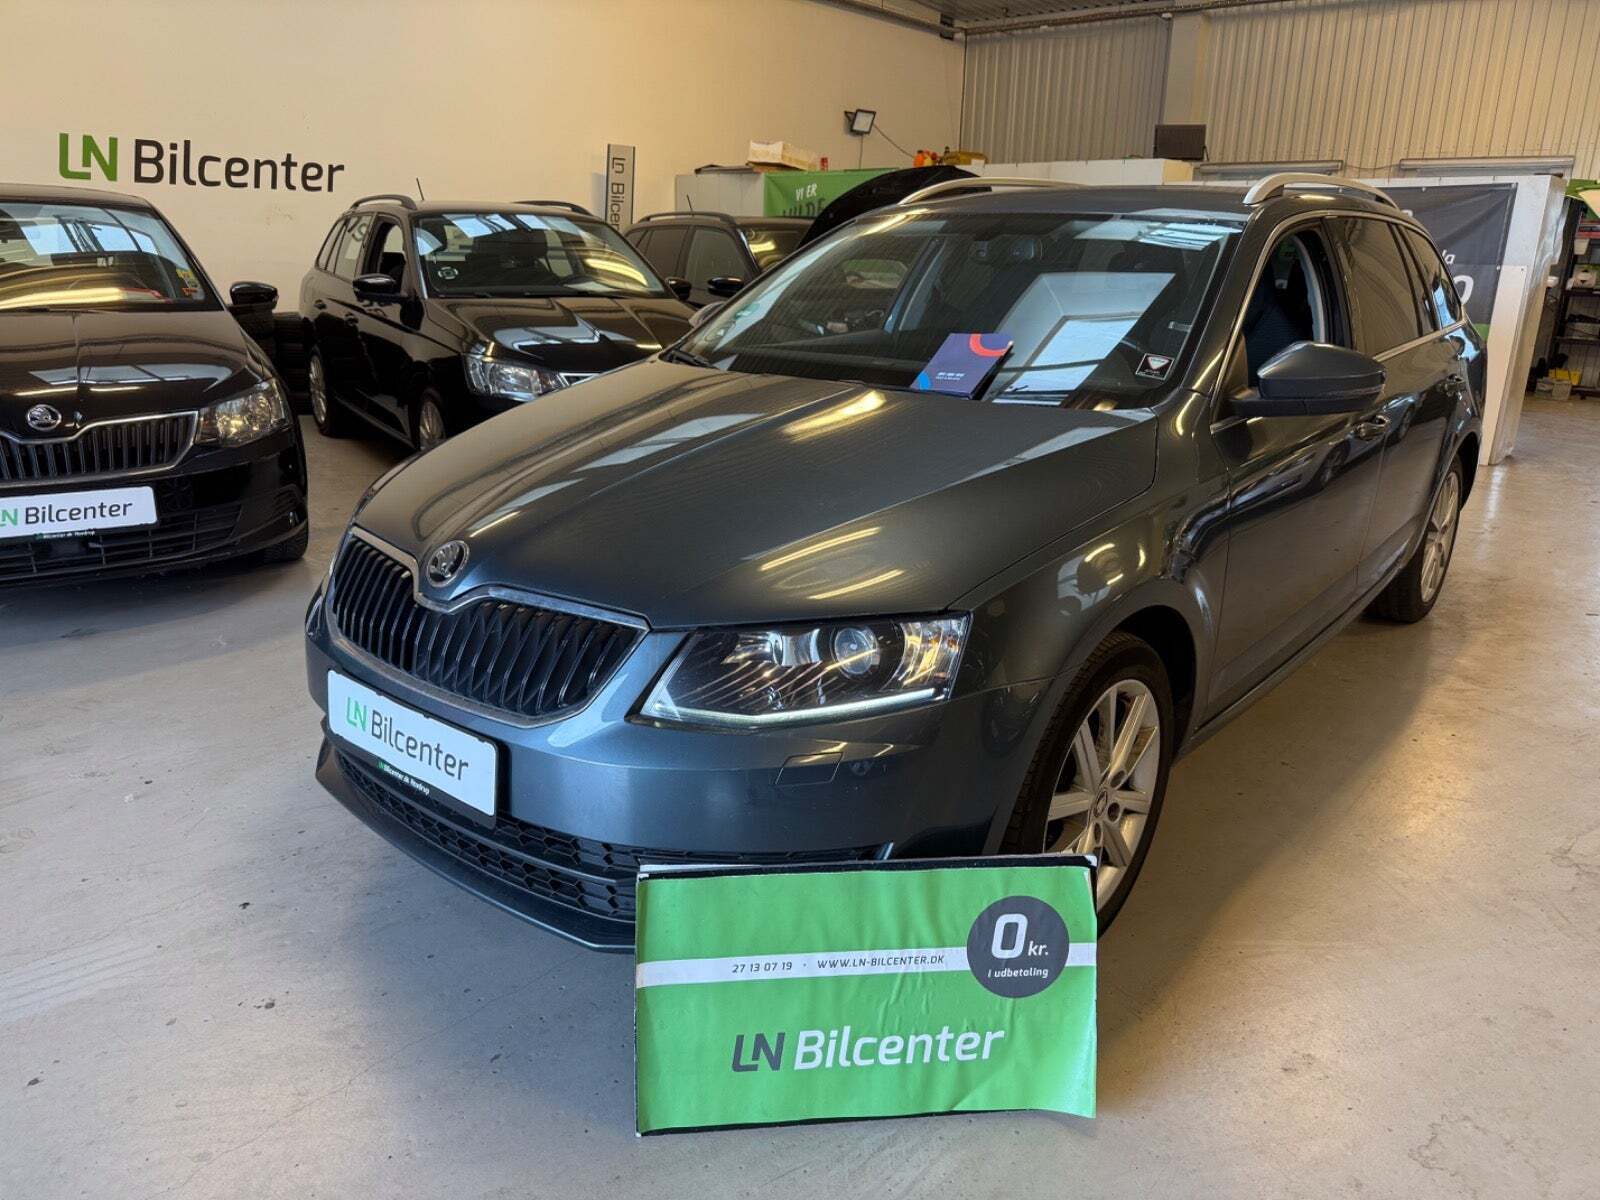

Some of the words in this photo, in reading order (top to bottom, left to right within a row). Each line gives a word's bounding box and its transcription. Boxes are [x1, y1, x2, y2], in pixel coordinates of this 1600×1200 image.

[59, 133, 118, 182] LN
[134, 139, 345, 192] Bilcenter
[612, 157, 626, 174] Ln
[806, 183, 817, 198] ER
[0, 508, 18, 527] N
[25, 501, 133, 525] Bilcenter
[346, 697, 367, 732] LN
[371, 709, 469, 780] Bilcenter
[991, 913, 1028, 959] 0
[1028, 940, 1049, 956] kr.
[732, 964, 746, 974] 27
[750, 963, 760, 973] 13
[764, 962, 777, 972] 07
[781, 961, 793, 971] 19
[817, 955, 945, 969] WWW.LN-BILCENTER.DK
[994, 967, 1049, 979] udbetaling
[731, 1032, 786, 1072] LN
[794, 1025, 1005, 1070] Bilcenter
